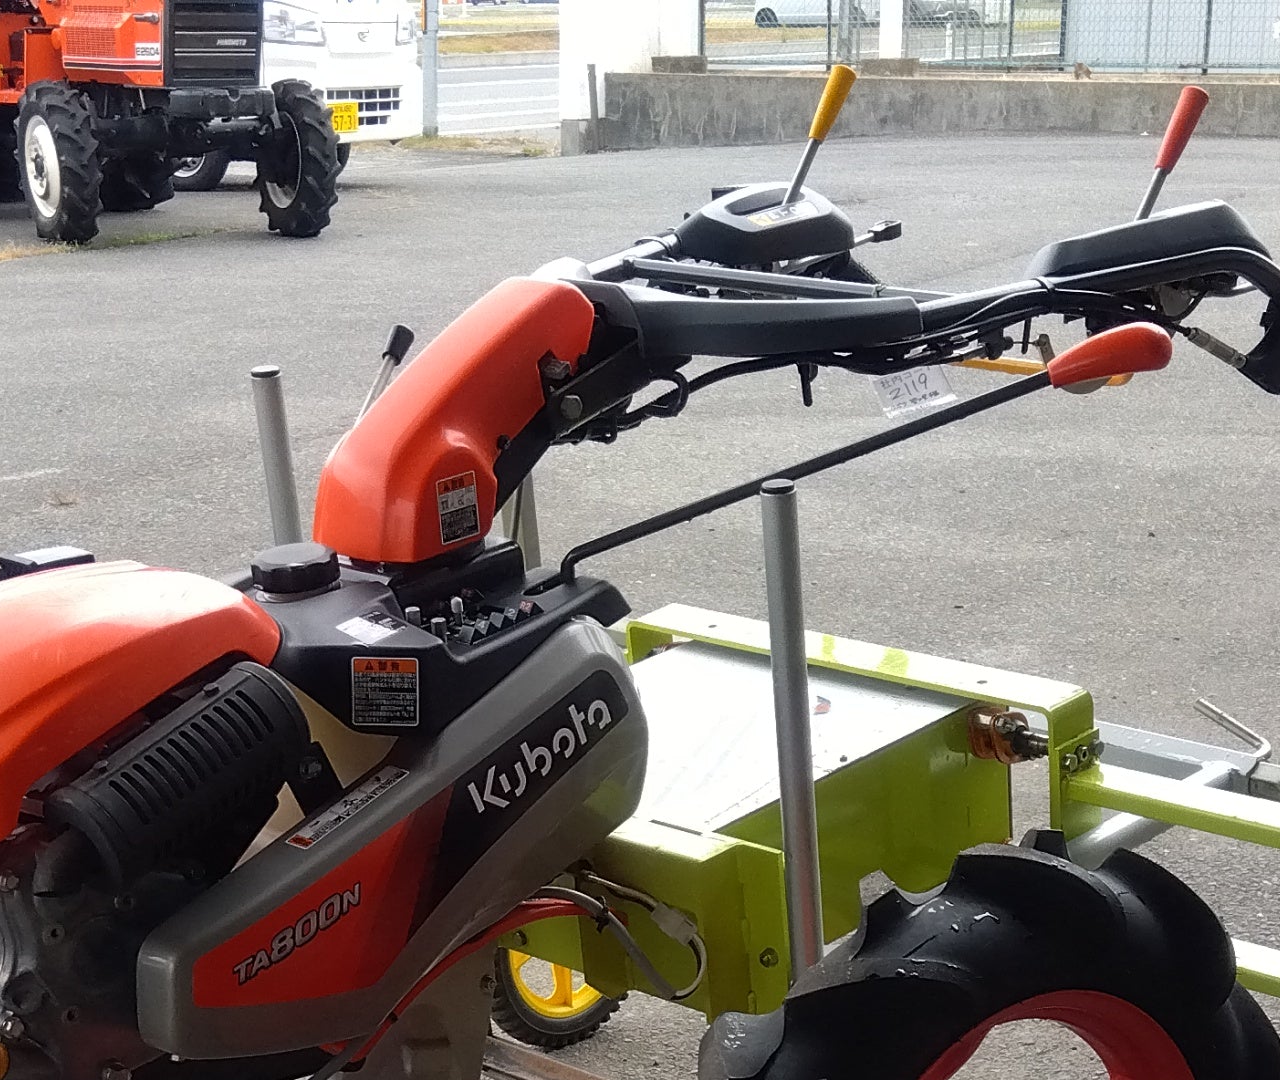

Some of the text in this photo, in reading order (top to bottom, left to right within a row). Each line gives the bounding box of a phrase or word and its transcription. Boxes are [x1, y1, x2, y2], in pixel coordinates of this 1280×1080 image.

[888, 373, 928, 400] 2119
[508, 608, 516, 617] 2
[467, 699, 612, 813] Kubota
[233, 882, 360, 985] TA800N
